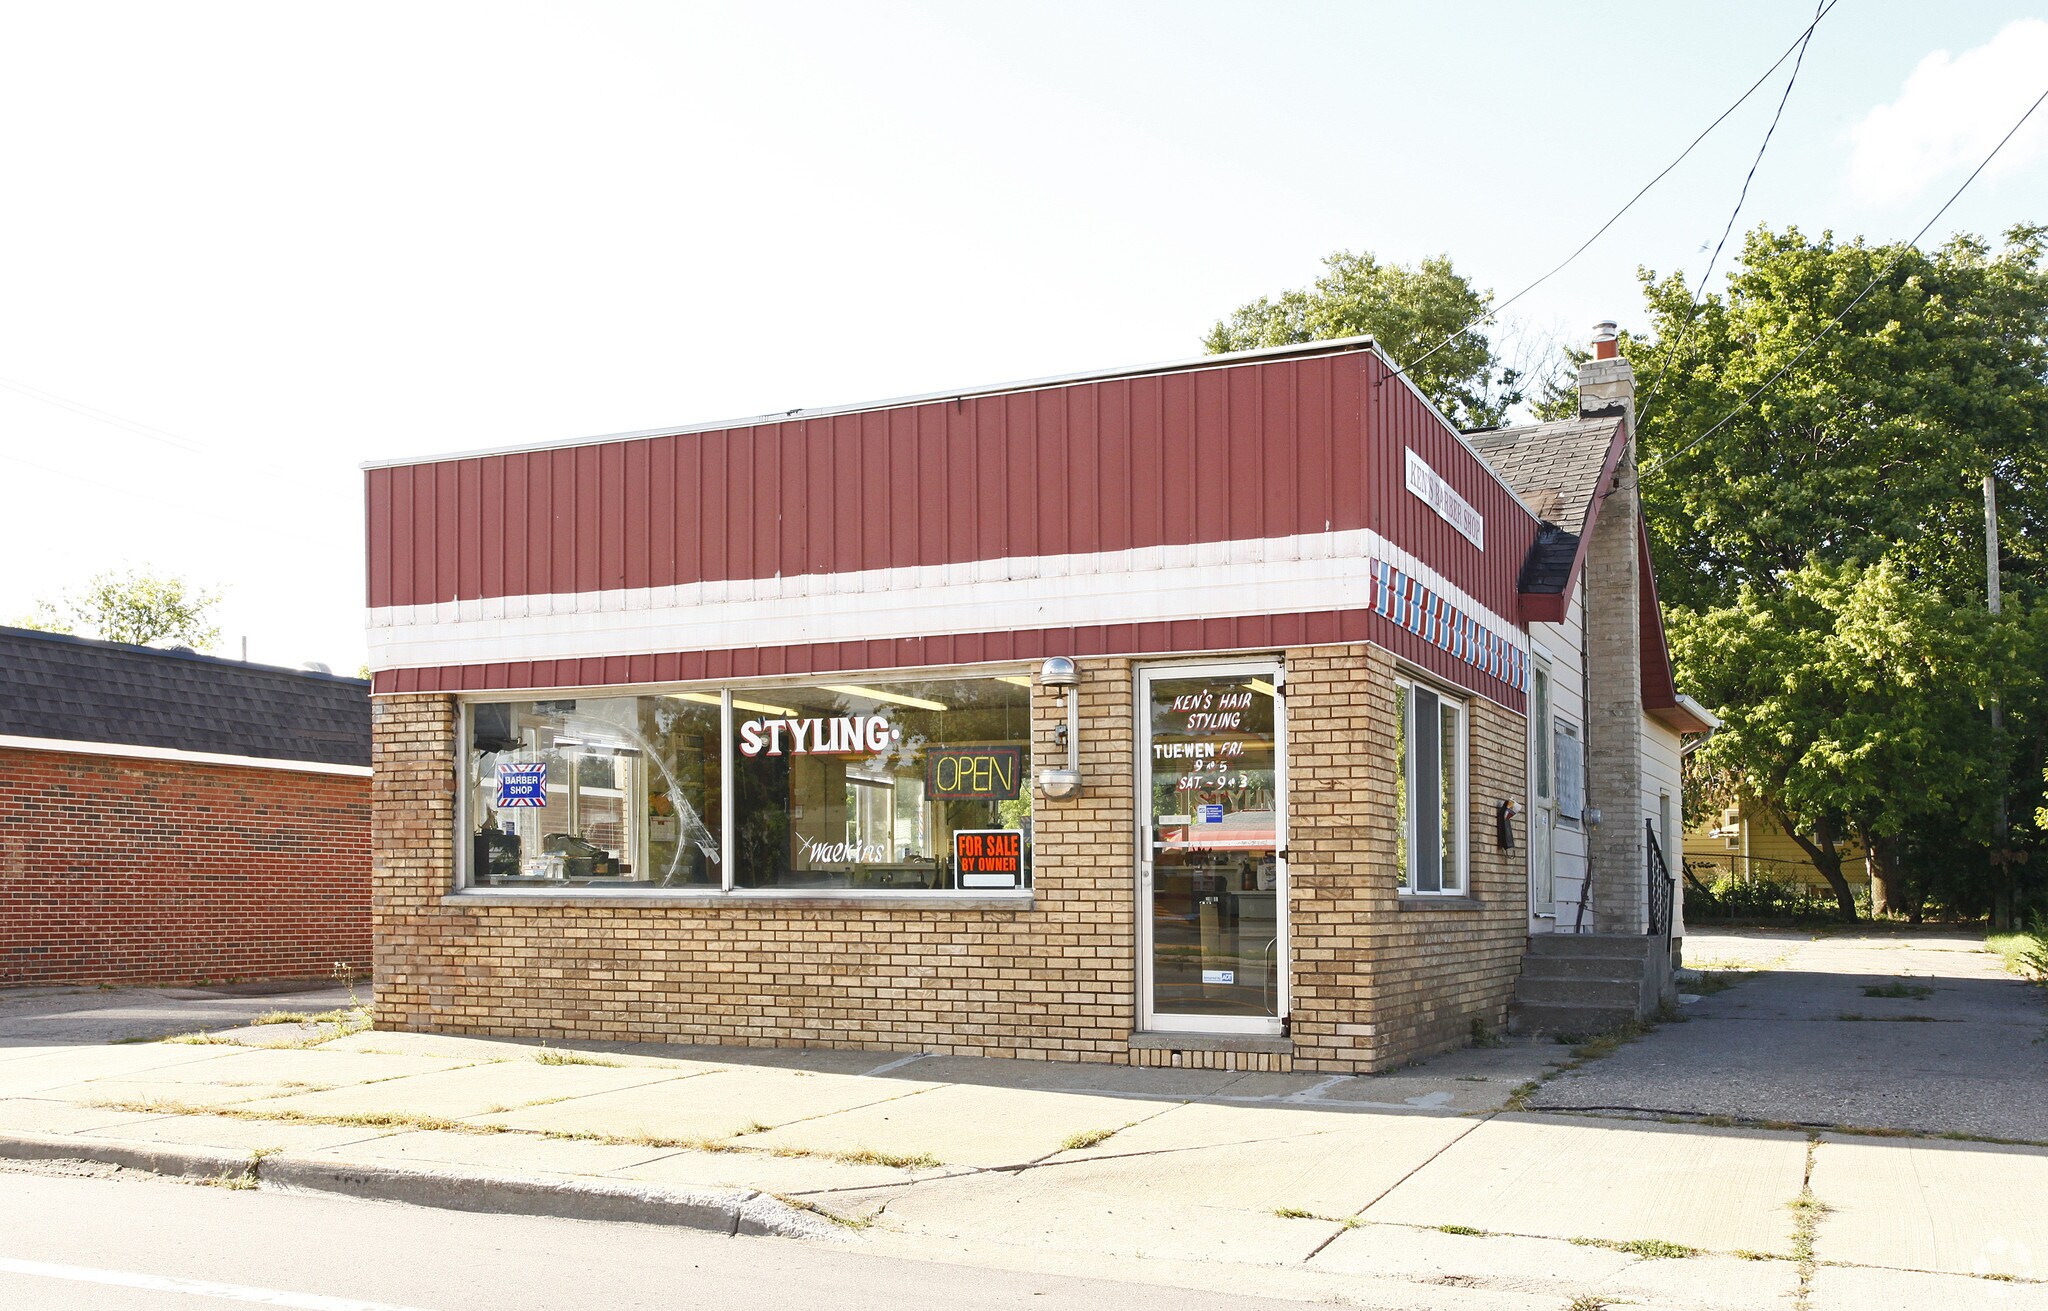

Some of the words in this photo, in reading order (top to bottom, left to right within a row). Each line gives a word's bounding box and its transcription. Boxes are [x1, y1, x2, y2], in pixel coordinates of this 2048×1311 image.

[1410, 460, 1434, 500] KEN'S
[1435, 482, 1462, 525] BARBER
[1463, 508, 1481, 541] SHOP
[1173, 689, 1213, 710] KEN'S
[1219, 692, 1252, 709] HAIR
[1187, 712, 1241, 729] STYLING
[937, 756, 1012, 791] OPEN
[1219, 761, 1228, 773] 5
[505, 776, 538, 784] BARBER
[1217, 775, 1226, 790] 9
[1239, 774, 1248, 788] 3
[510, 786, 533, 794] SHOP
[958, 835, 983, 857] FOR
[986, 835, 1019, 857] SALE
[961, 857, 975, 872] BY
[978, 857, 1016, 872] OWNER
